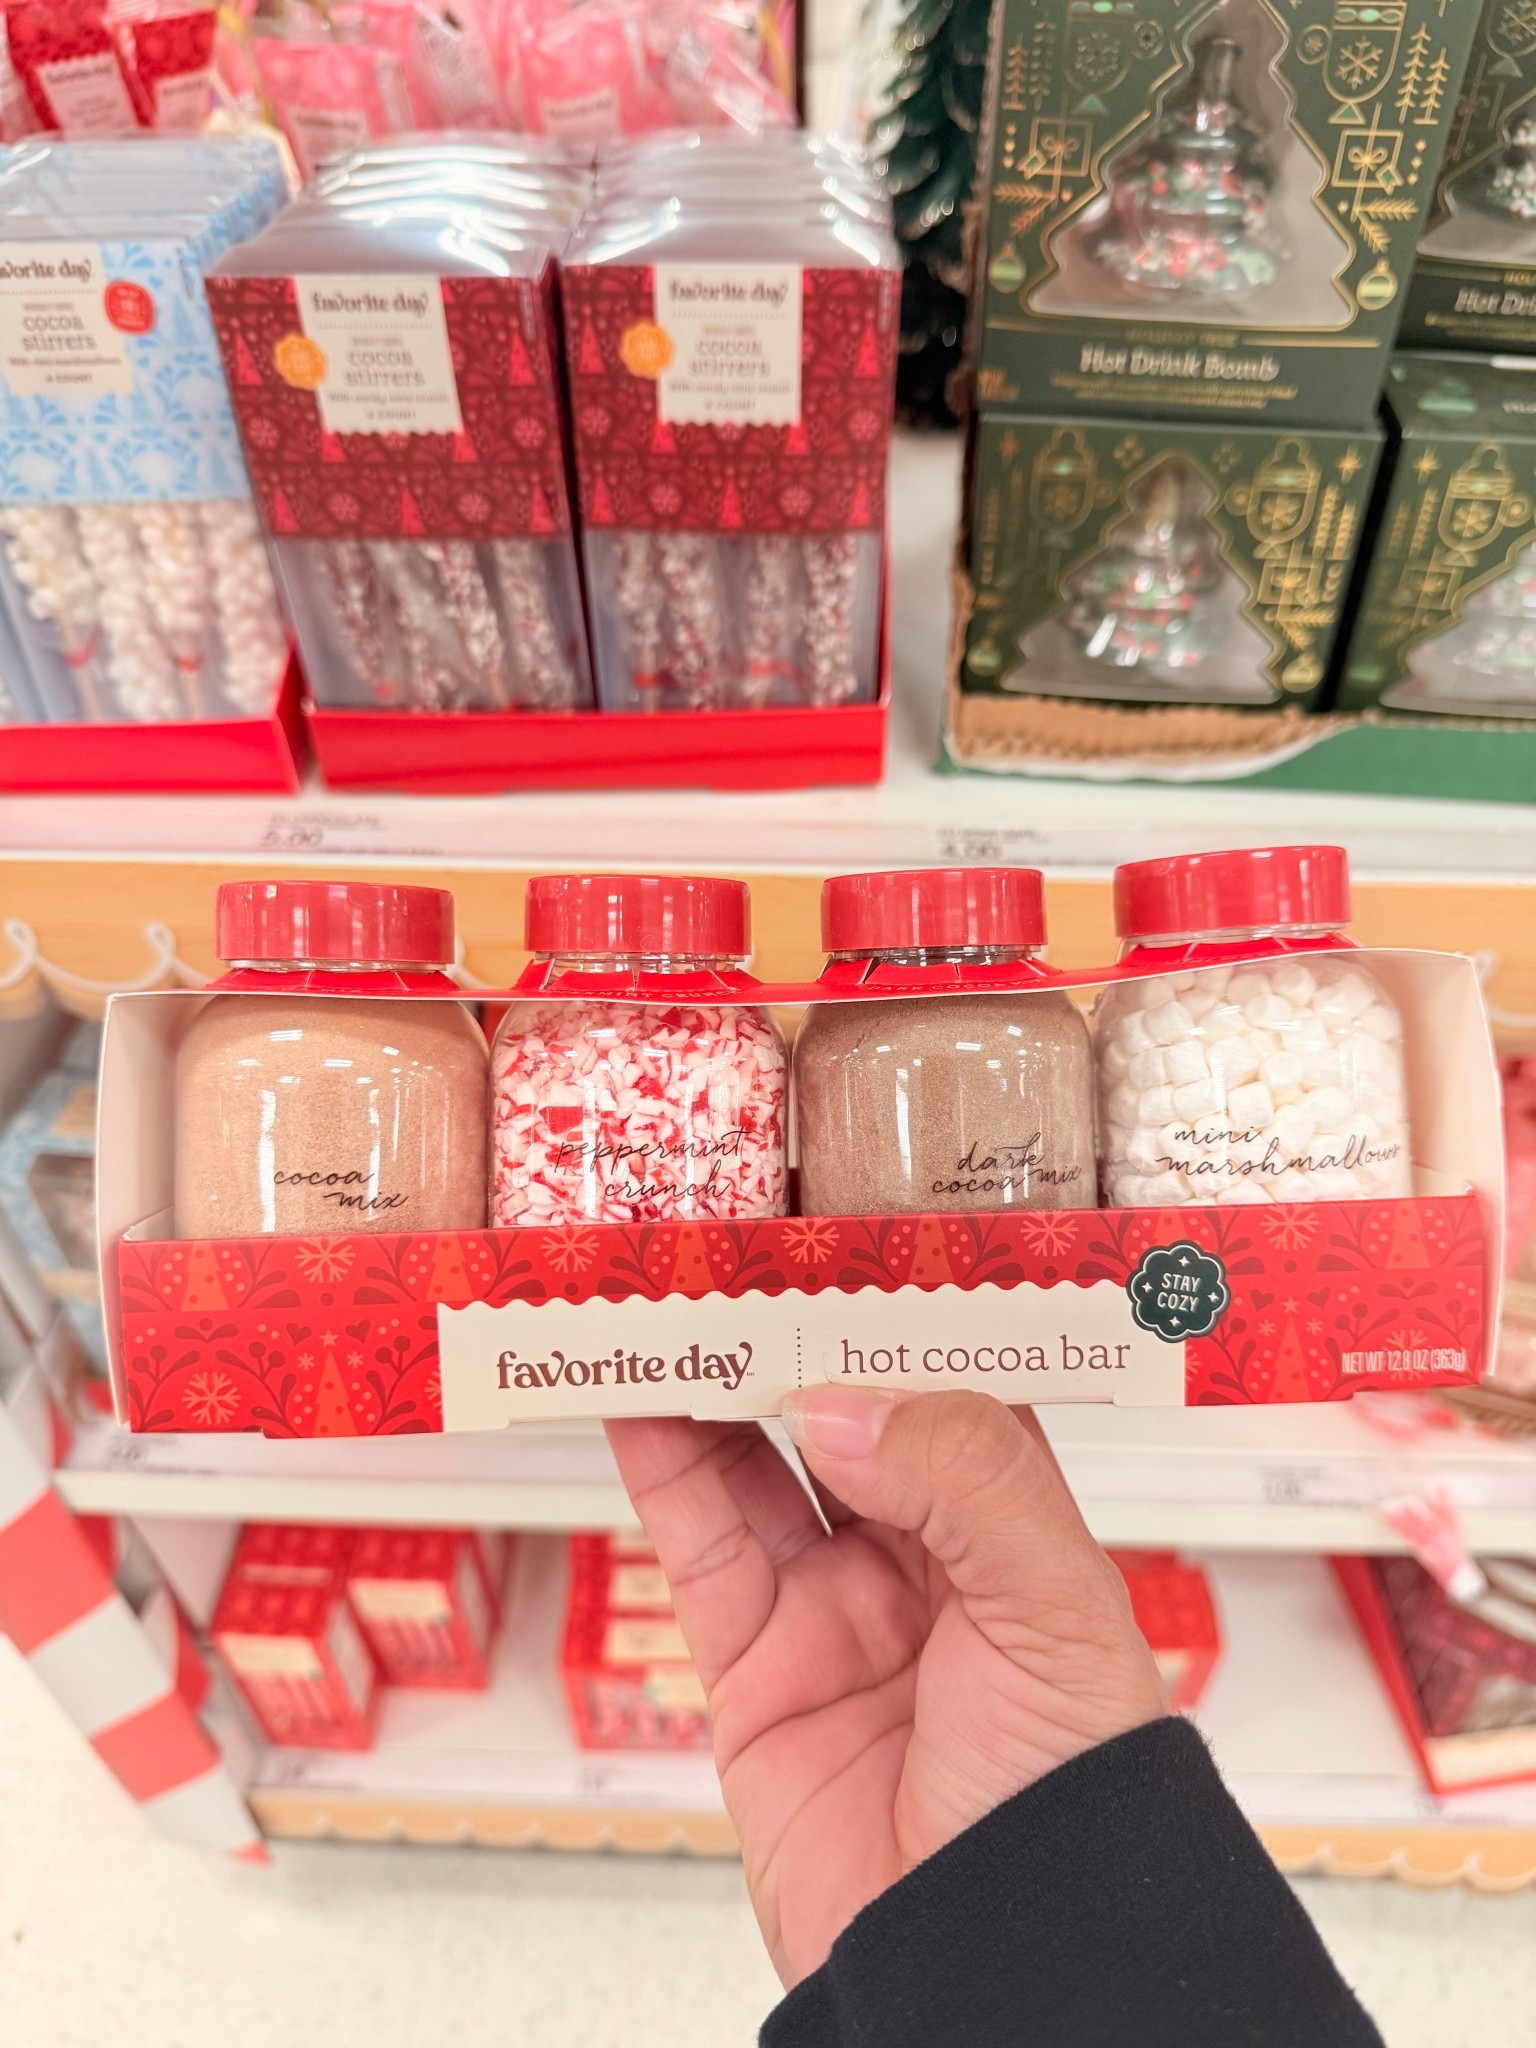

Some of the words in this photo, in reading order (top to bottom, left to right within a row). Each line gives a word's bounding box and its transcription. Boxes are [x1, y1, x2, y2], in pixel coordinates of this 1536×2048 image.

[58, 258, 92, 283] day
[312, 289, 389, 313] favorite
[392, 288, 429, 318] day
[668, 279, 748, 302] favorite
[751, 279, 790, 309] day
[22, 315, 85, 332] cocoa
[21, 333, 98, 351] stirrers
[347, 351, 414, 367] cocoa
[1080, 343, 1128, 375] Hot
[1130, 345, 1202, 378] Drink
[1203, 351, 1281, 382] Bomb
[344, 369, 427, 388] stirrers
[1174, 1126, 1263, 1145] mini
[554, 1126, 752, 1175] peppermint
[957, 1131, 1046, 1172] dark
[1155, 1134, 1400, 1176] marshmallows
[273, 1170, 375, 1186] cocoa
[604, 1159, 731, 1198] crunch
[932, 1174, 1026, 1193] cocoa
[1028, 1164, 1082, 1186] mix
[323, 1191, 409, 1211] mix
[1161, 1272, 1201, 1293] STAY
[1157, 1291, 1198, 1313] COZY
[496, 1348, 667, 1389] favorite
[674, 1341, 753, 1390] day
[841, 1338, 911, 1374] hot
[922, 1344, 1050, 1373] cocoa
[1059, 1334, 1131, 1370] bar
[1342, 1352, 1364, 1373] NET
[1365, 1350, 1385, 1372] WT
[1387, 1350, 1410, 1371] 12.8
[1413, 1349, 1428, 1370] OZ
[1430, 1347, 1466, 1373] (363g)
